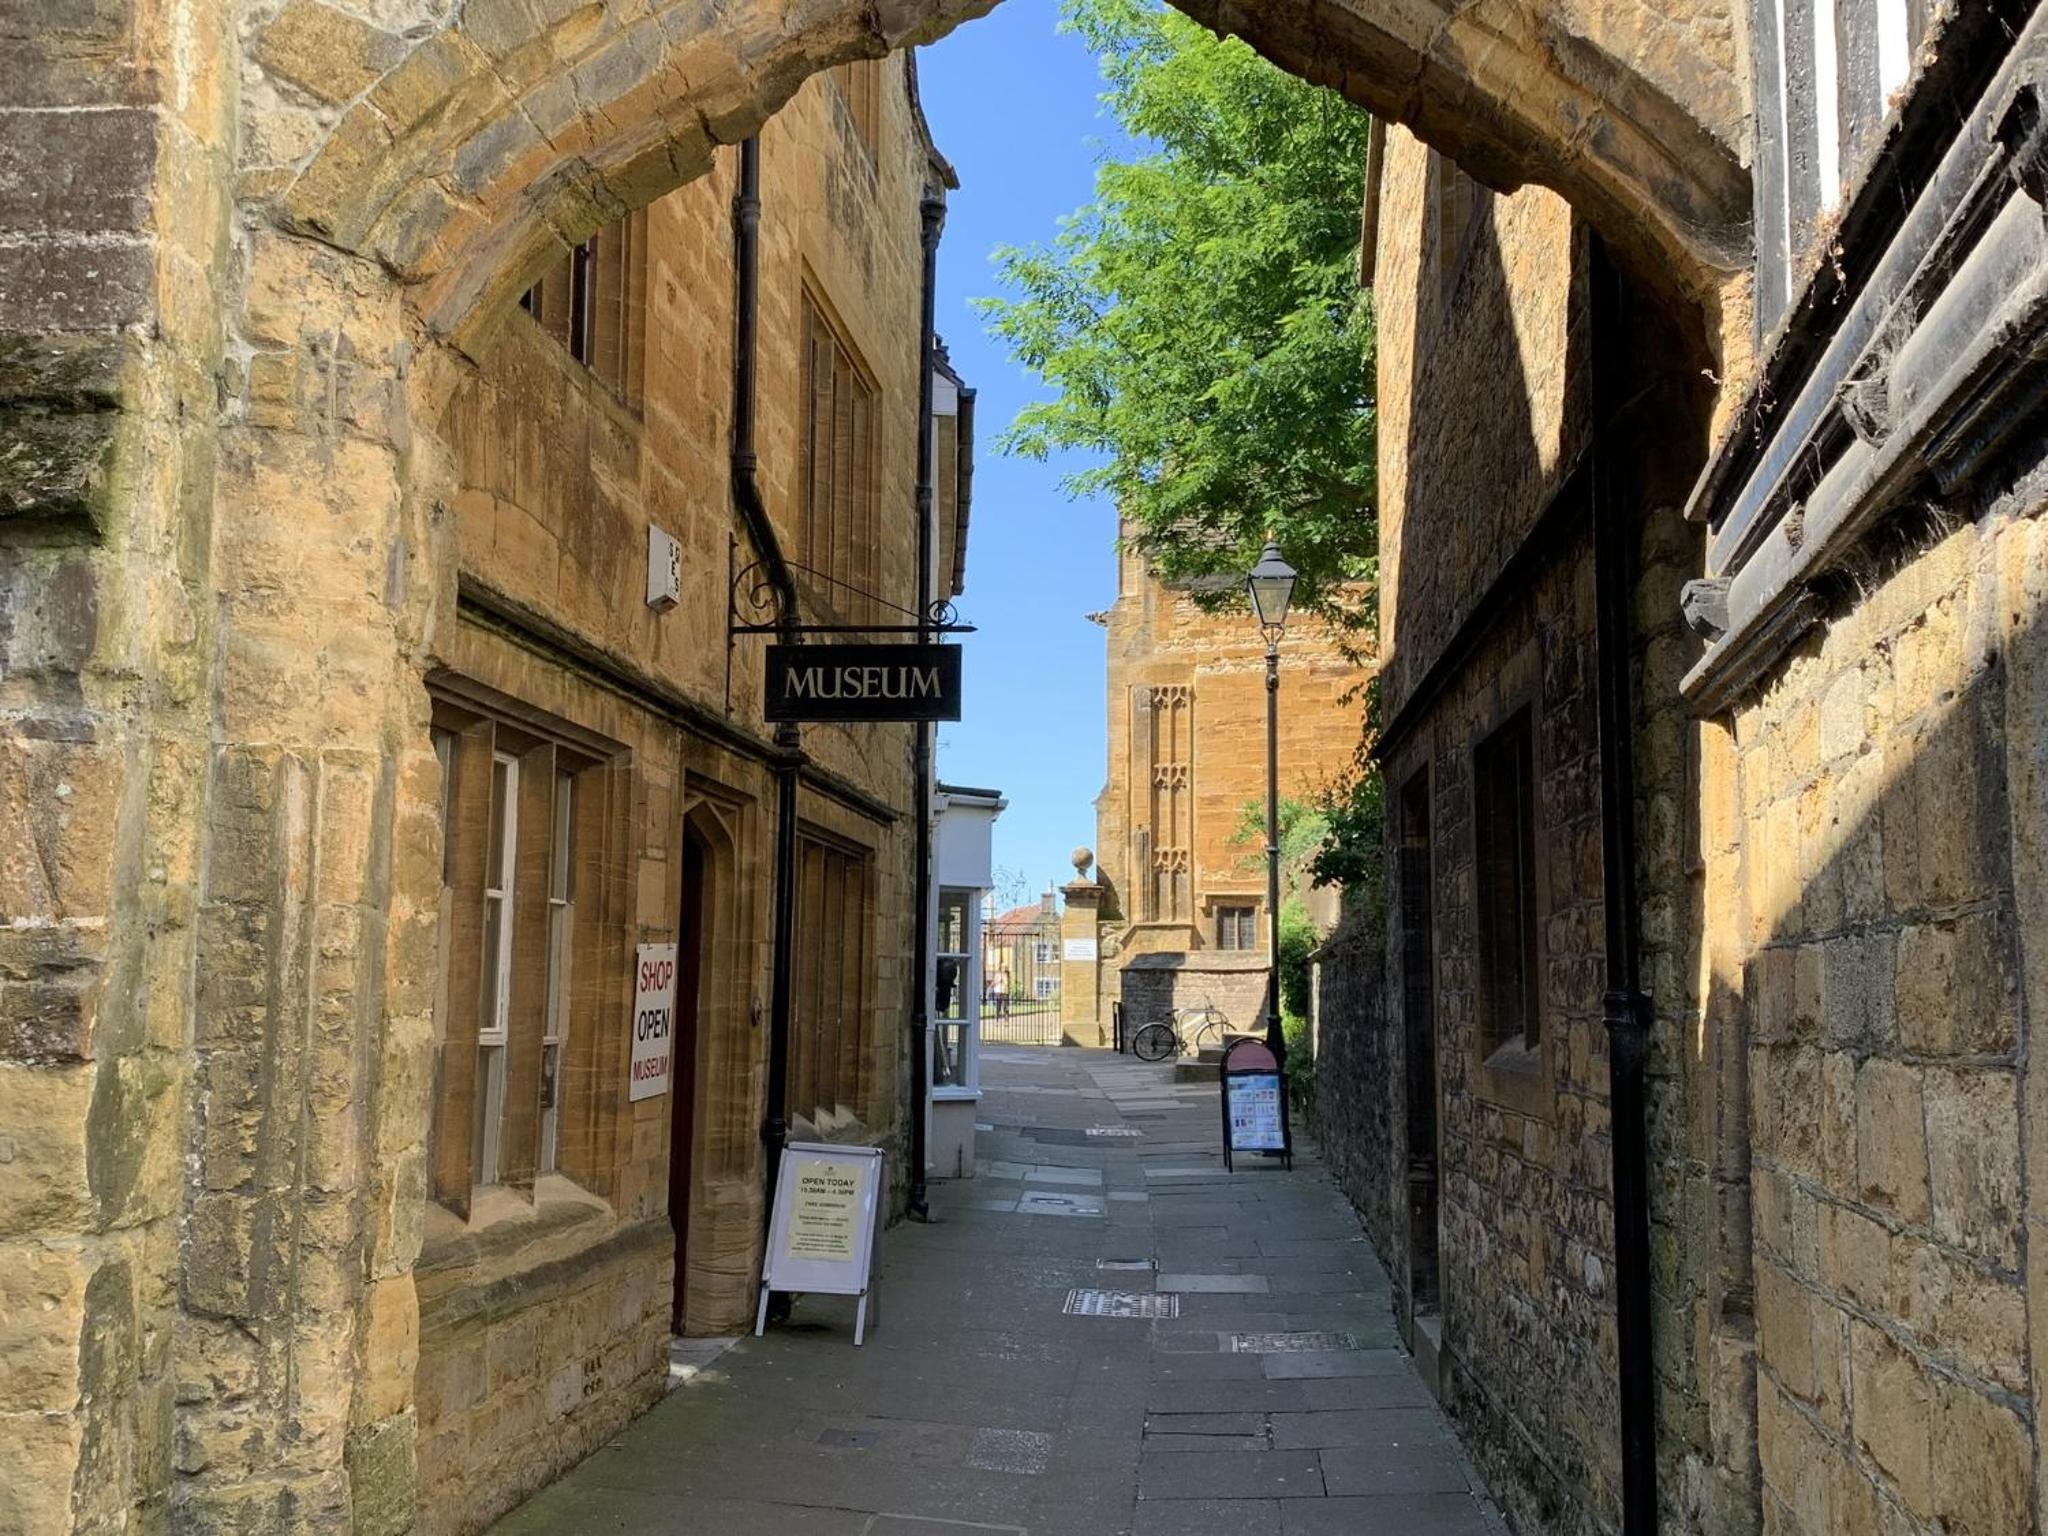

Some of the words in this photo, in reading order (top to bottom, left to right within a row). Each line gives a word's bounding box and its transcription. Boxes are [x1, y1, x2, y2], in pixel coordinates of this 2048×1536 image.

[784, 667, 942, 698] MUSEUM
[640, 960, 673, 992] SHOP
[638, 1007, 670, 1041] OPEN
[633, 1055, 667, 1081] MUSEUM
